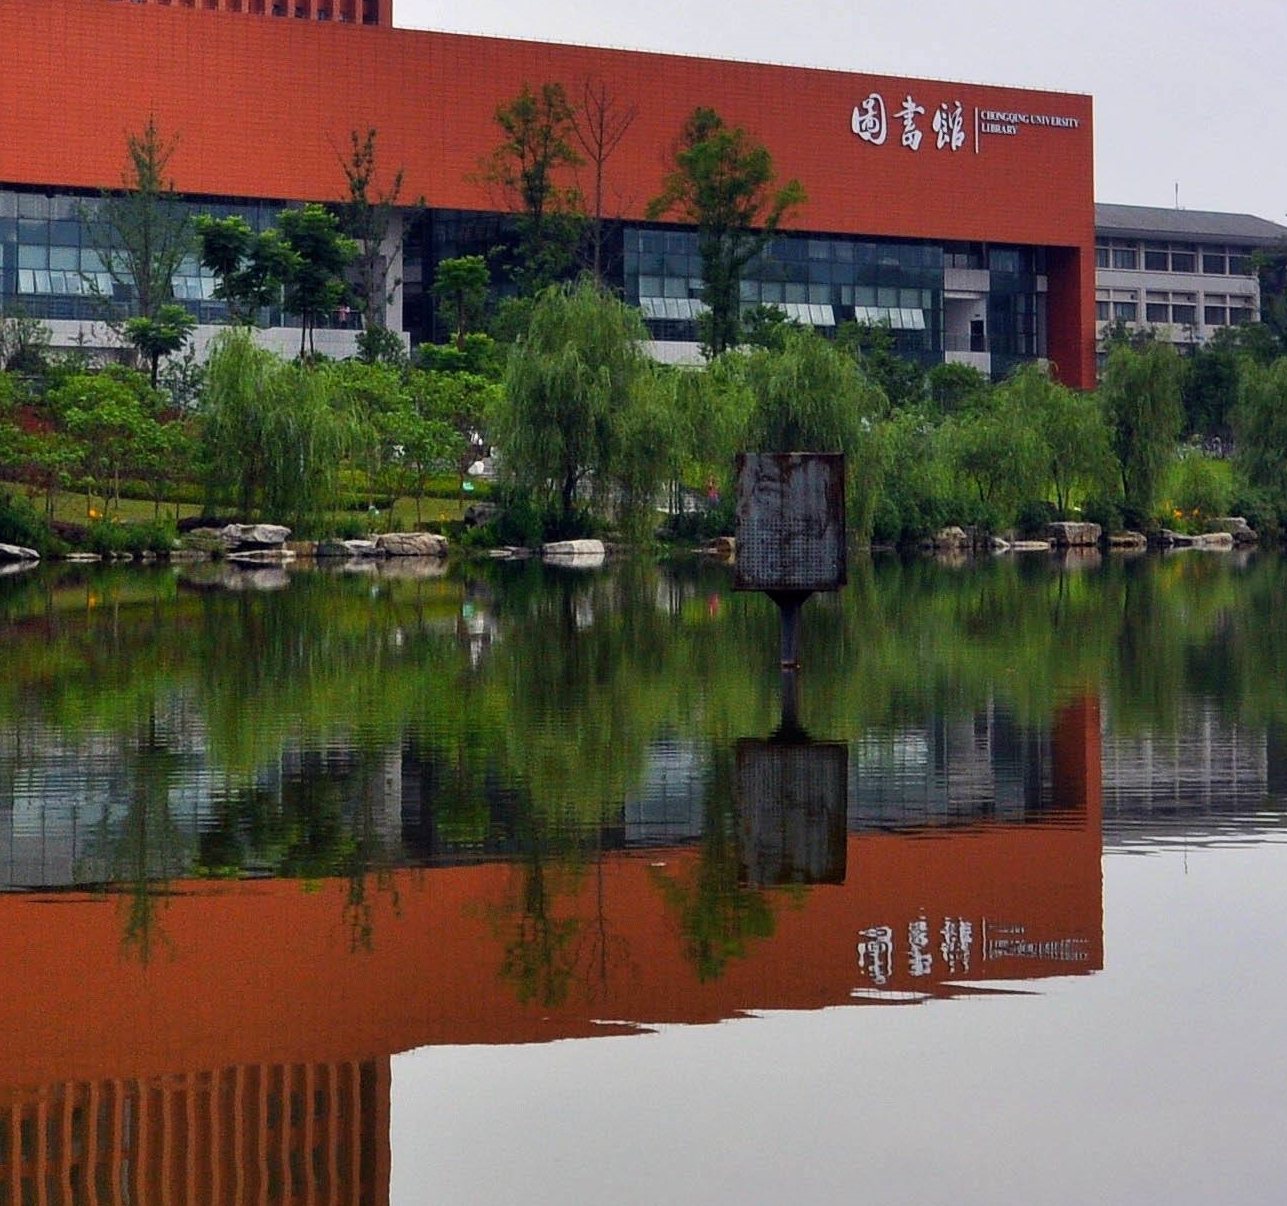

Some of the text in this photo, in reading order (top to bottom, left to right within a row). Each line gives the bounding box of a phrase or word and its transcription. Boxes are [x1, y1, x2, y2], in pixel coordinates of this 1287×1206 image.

[981, 110, 1079, 128] CHONGQING UNIVERSITY
[981, 122, 1017, 135] LIBRARY
